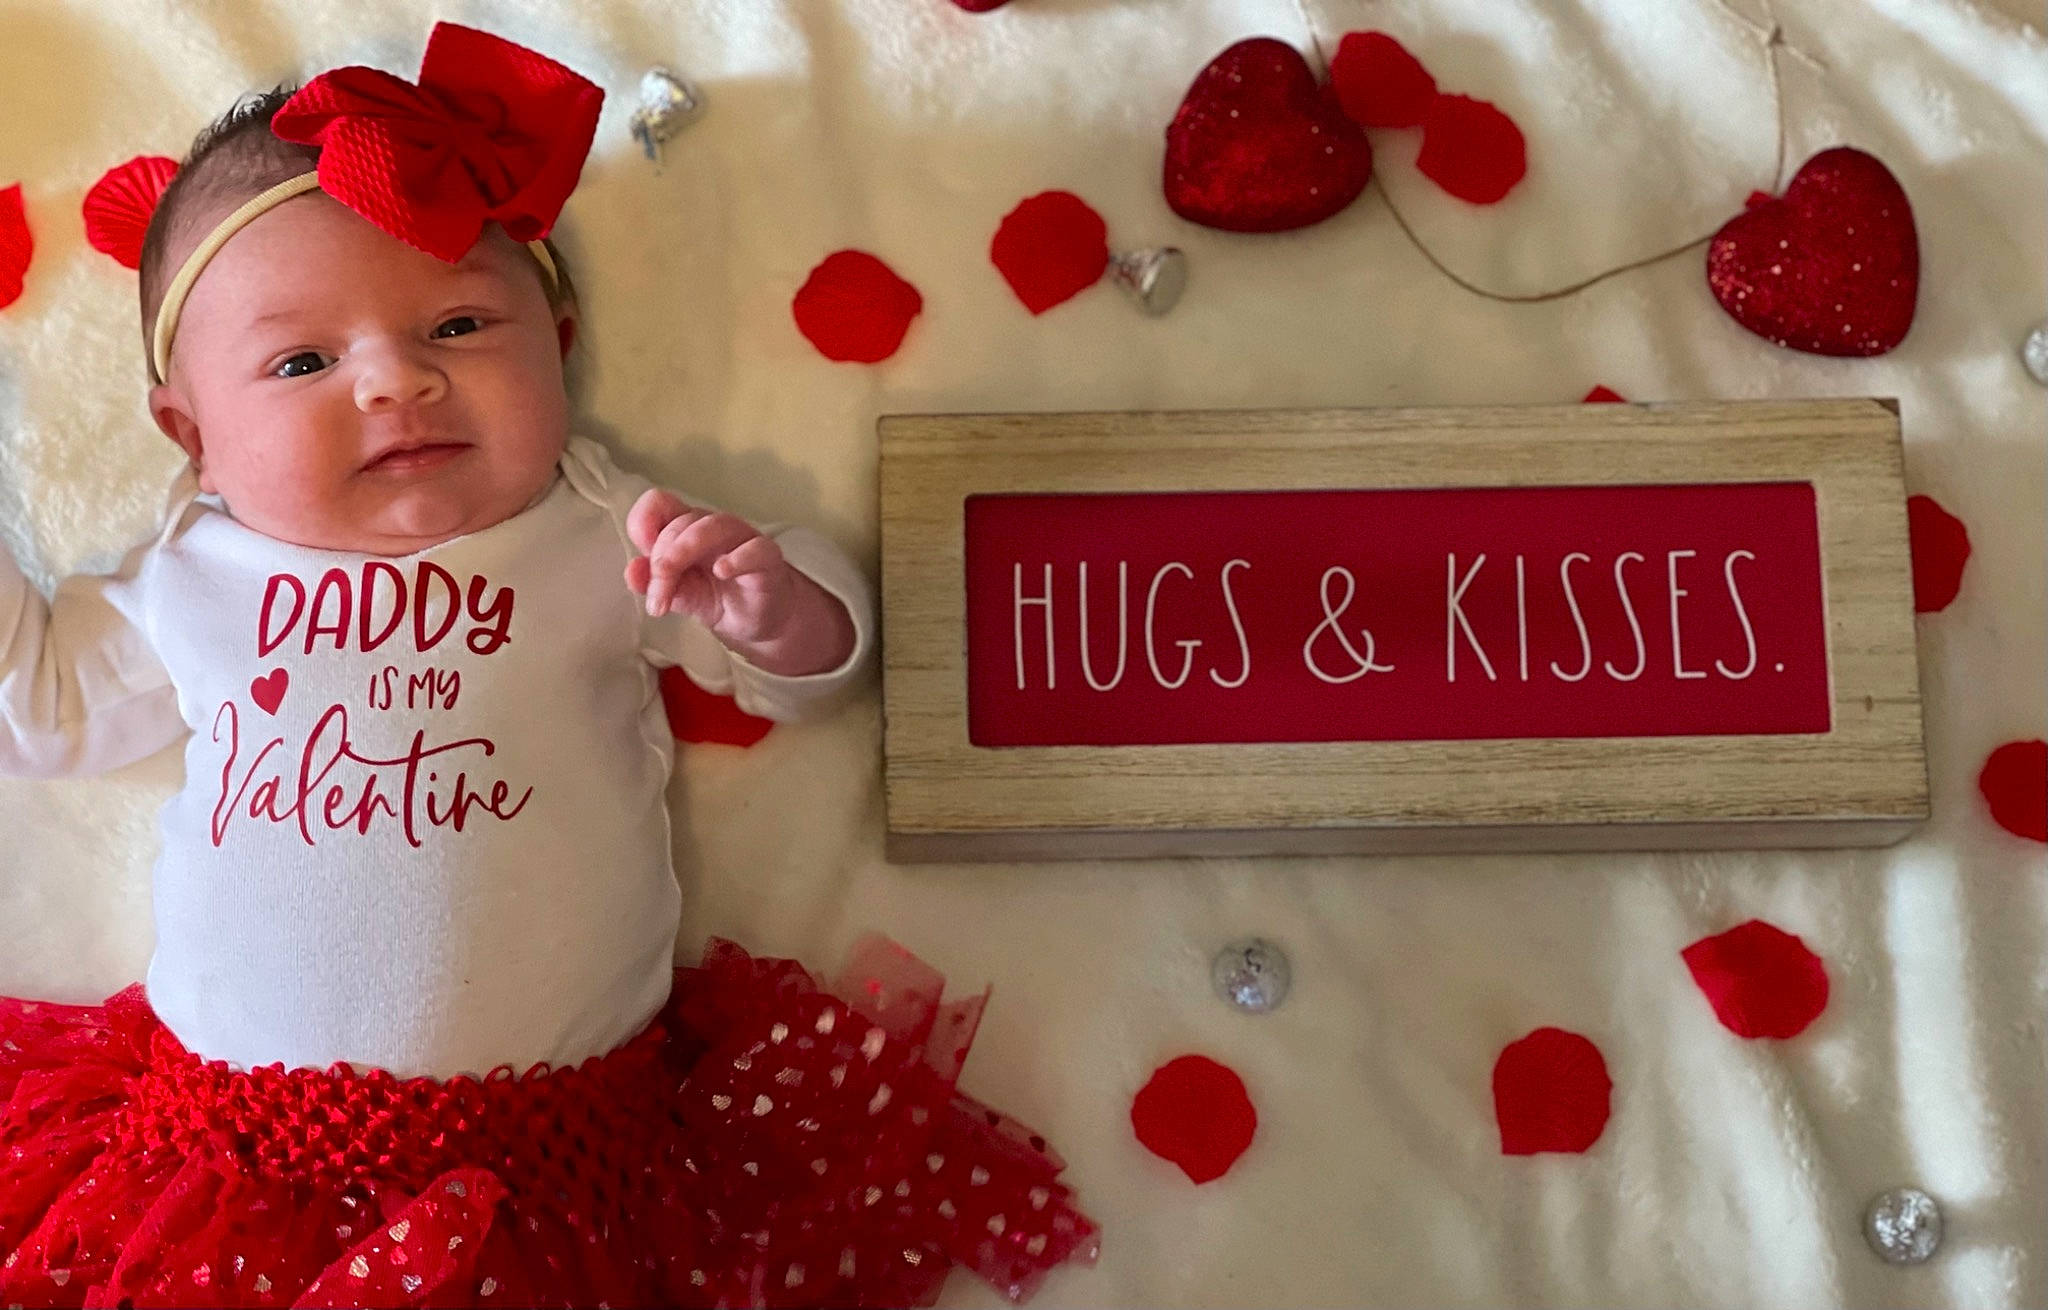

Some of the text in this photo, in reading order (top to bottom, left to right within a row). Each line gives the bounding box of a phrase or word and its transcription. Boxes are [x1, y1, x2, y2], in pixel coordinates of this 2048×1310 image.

[368, 665, 461, 711] IS MY
[1013, 549, 1786, 692] HUGS & KISSES.
[211, 700, 534, 848] Valentine
